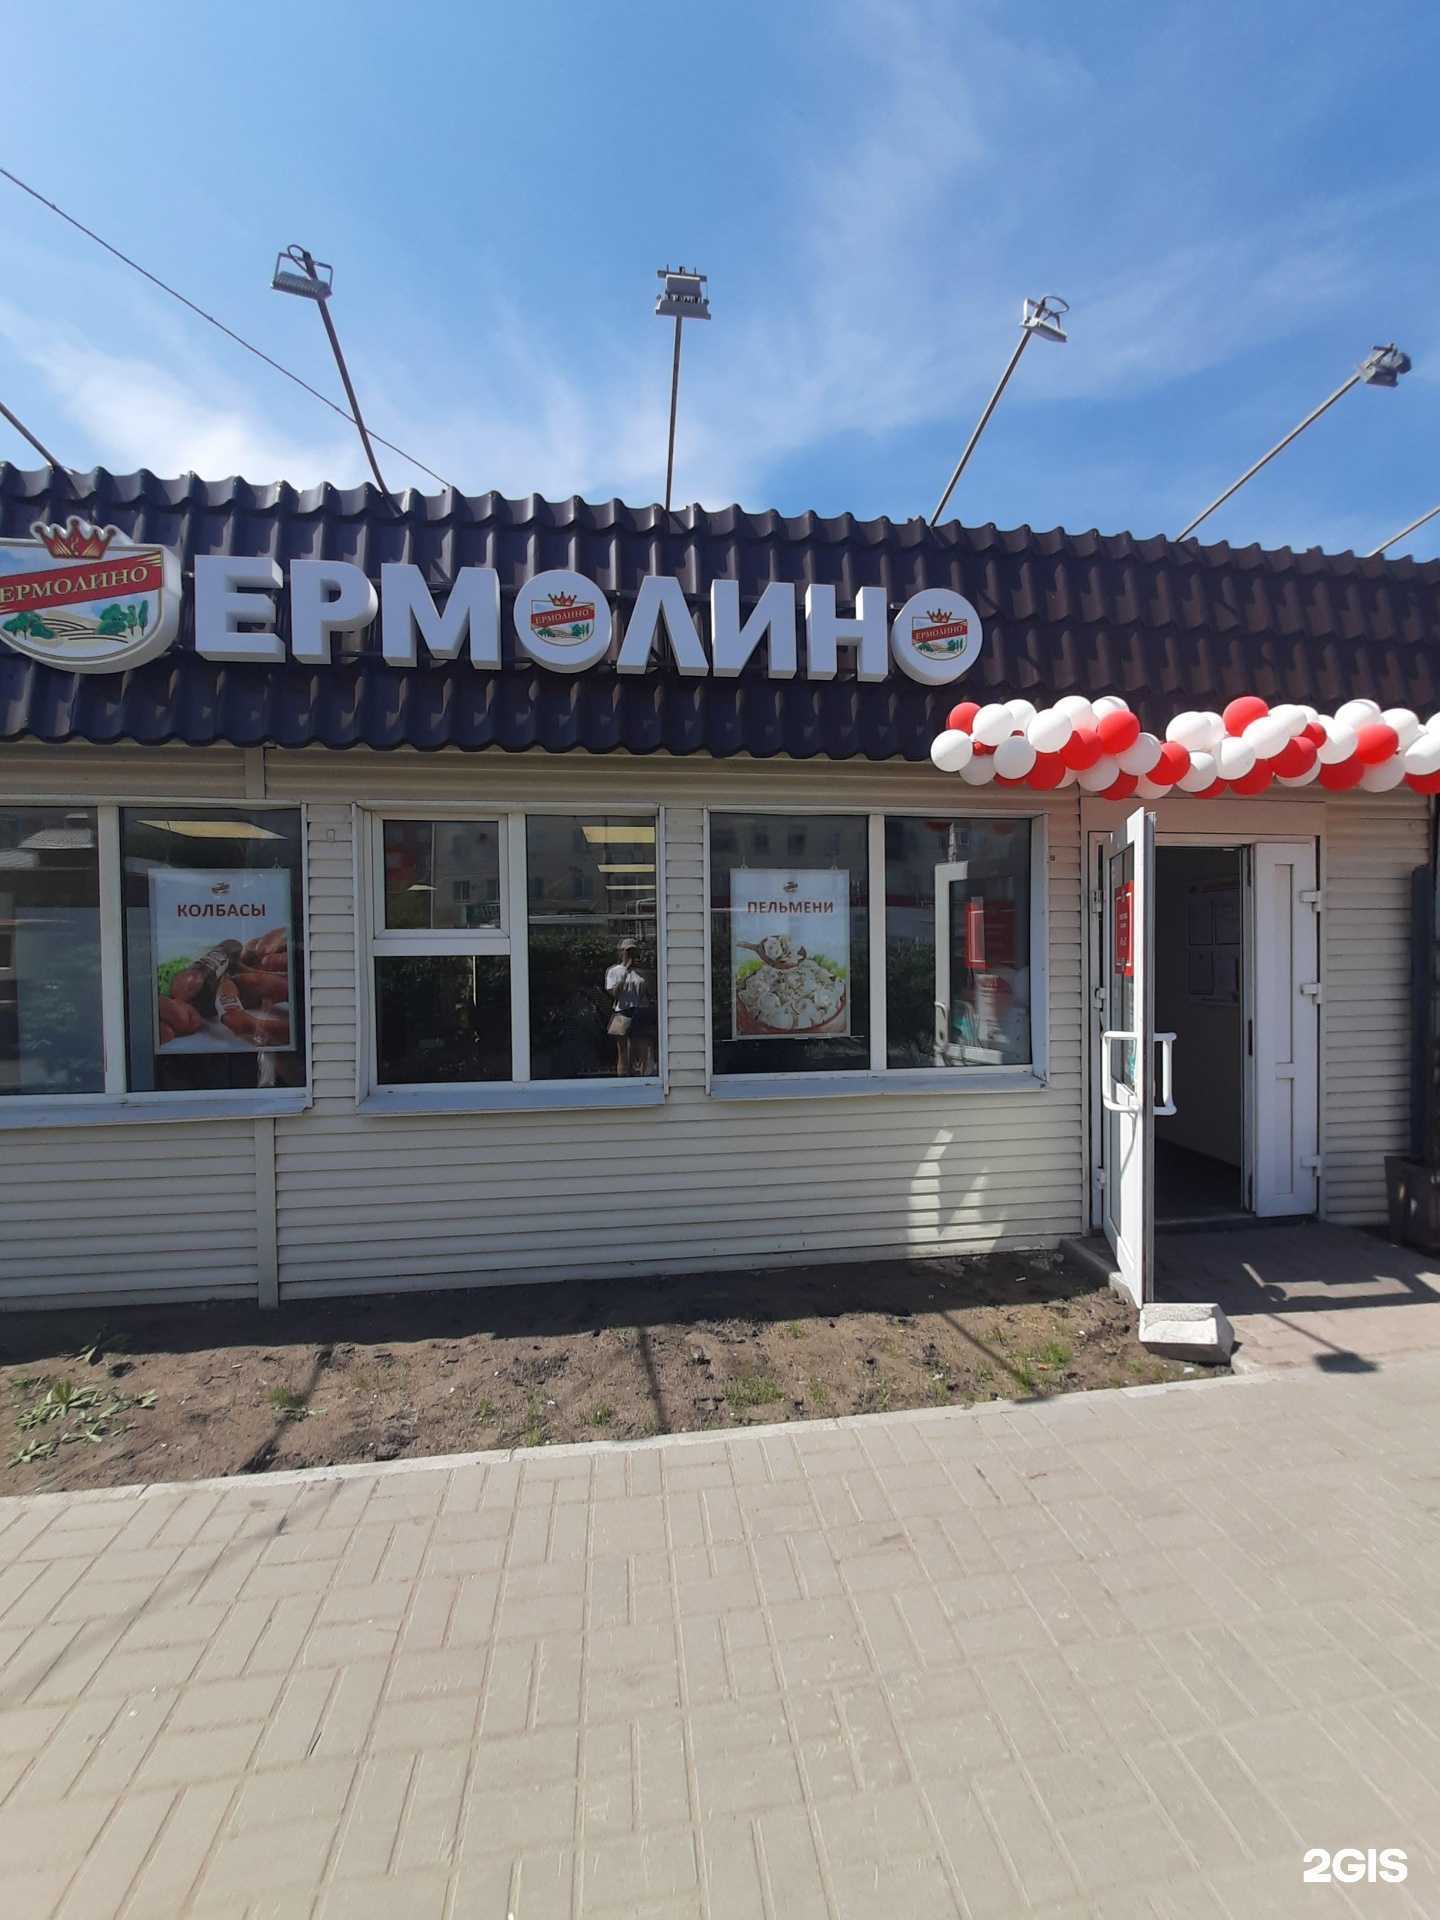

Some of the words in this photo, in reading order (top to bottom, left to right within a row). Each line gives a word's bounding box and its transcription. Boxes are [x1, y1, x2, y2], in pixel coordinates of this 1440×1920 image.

[0, 566, 148, 601] ЕРМОЛИНО
[194, 554, 983, 686] ЕРМОЛИНО
[177, 903, 266, 917] КОЛБАСЫ
[747, 901, 833, 913] ПЕЛЬМЕНИ
